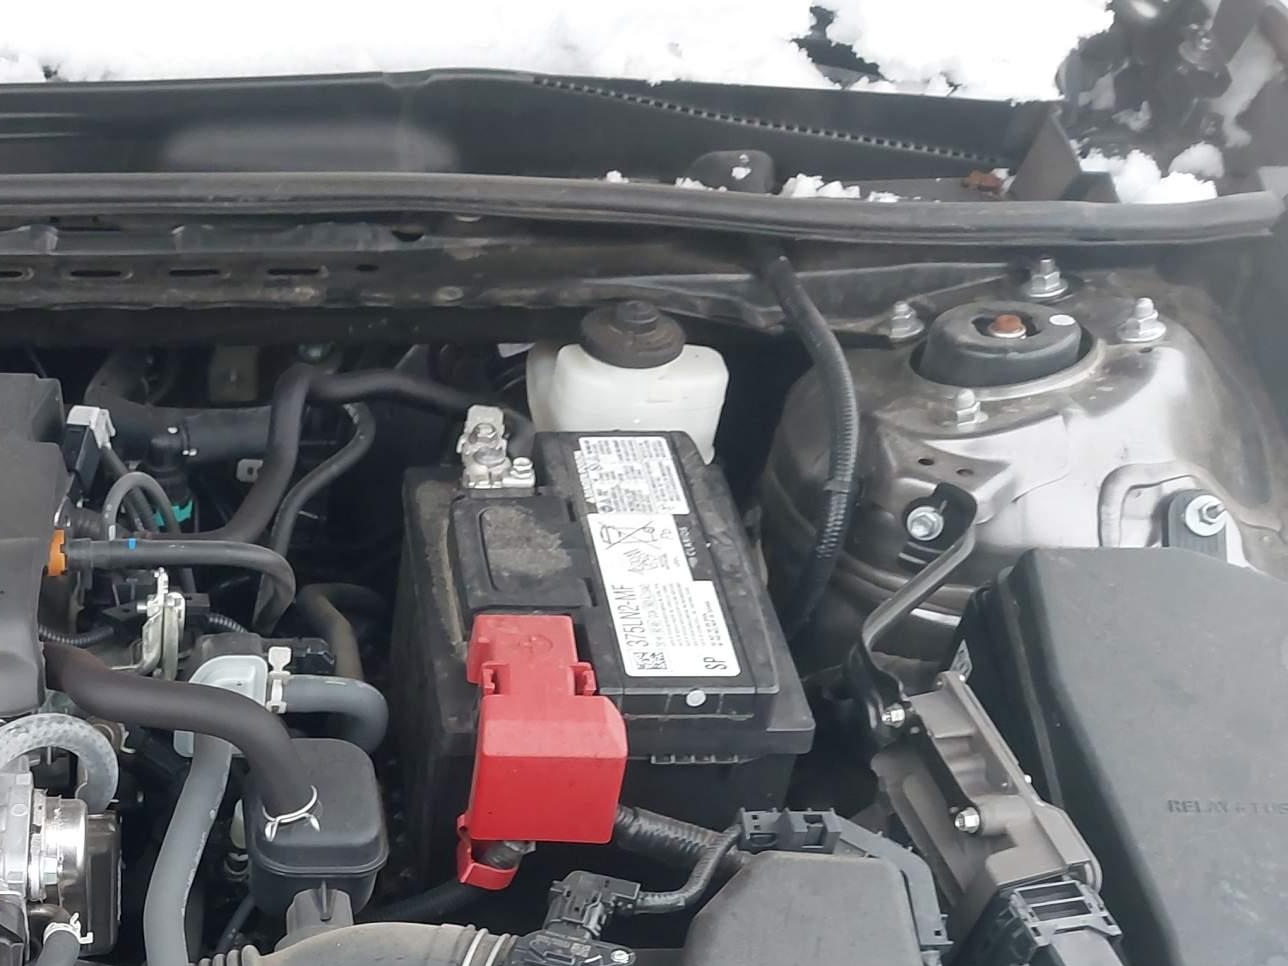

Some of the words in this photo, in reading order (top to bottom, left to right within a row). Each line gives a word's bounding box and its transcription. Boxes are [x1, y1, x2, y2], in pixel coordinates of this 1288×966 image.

[611, 584, 649, 647] 375LN2-MF
[703, 656, 728, 670] SP
[1167, 799, 1228, 813] RELAY
